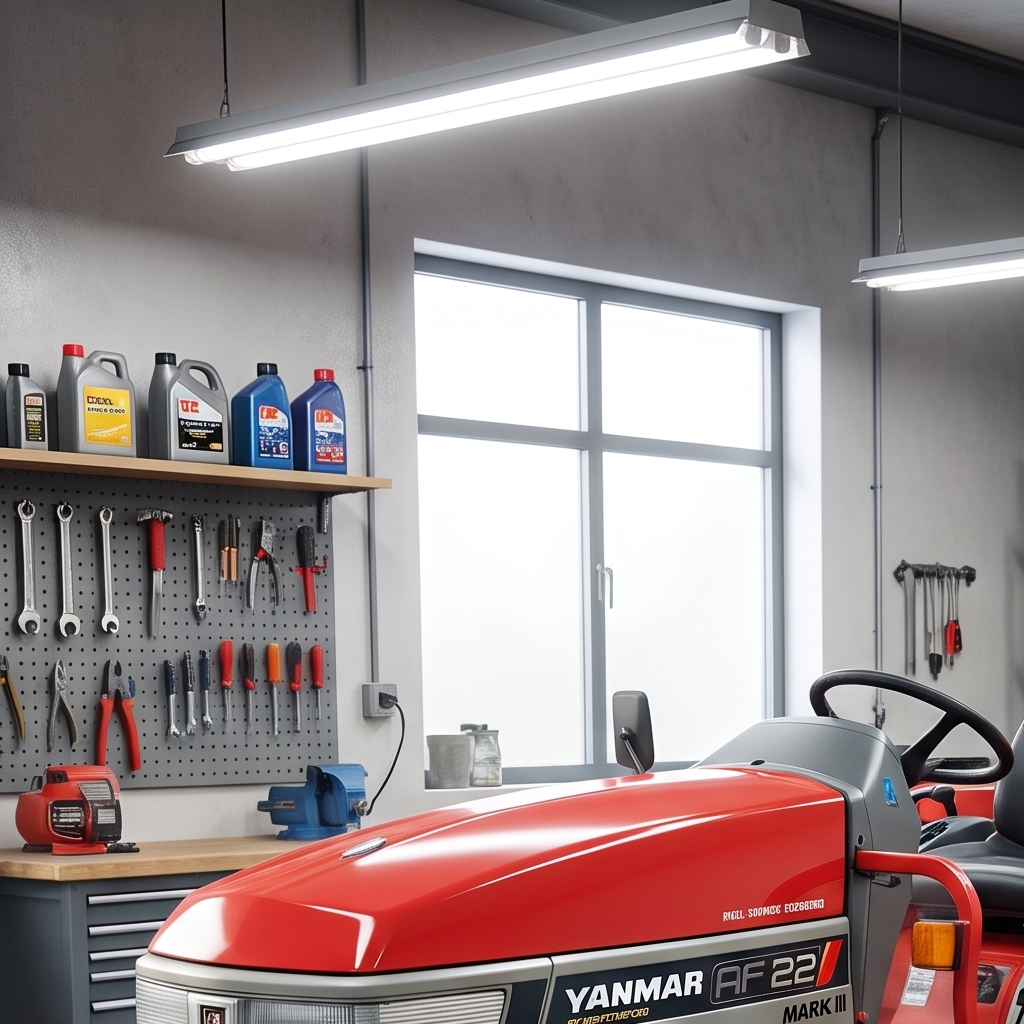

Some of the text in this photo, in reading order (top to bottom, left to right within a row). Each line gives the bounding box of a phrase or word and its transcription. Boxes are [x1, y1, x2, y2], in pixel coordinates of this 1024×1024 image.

[565, 953, 817, 1014] YANMAR AF 22
[782, 993, 847, 1024] MARK III
